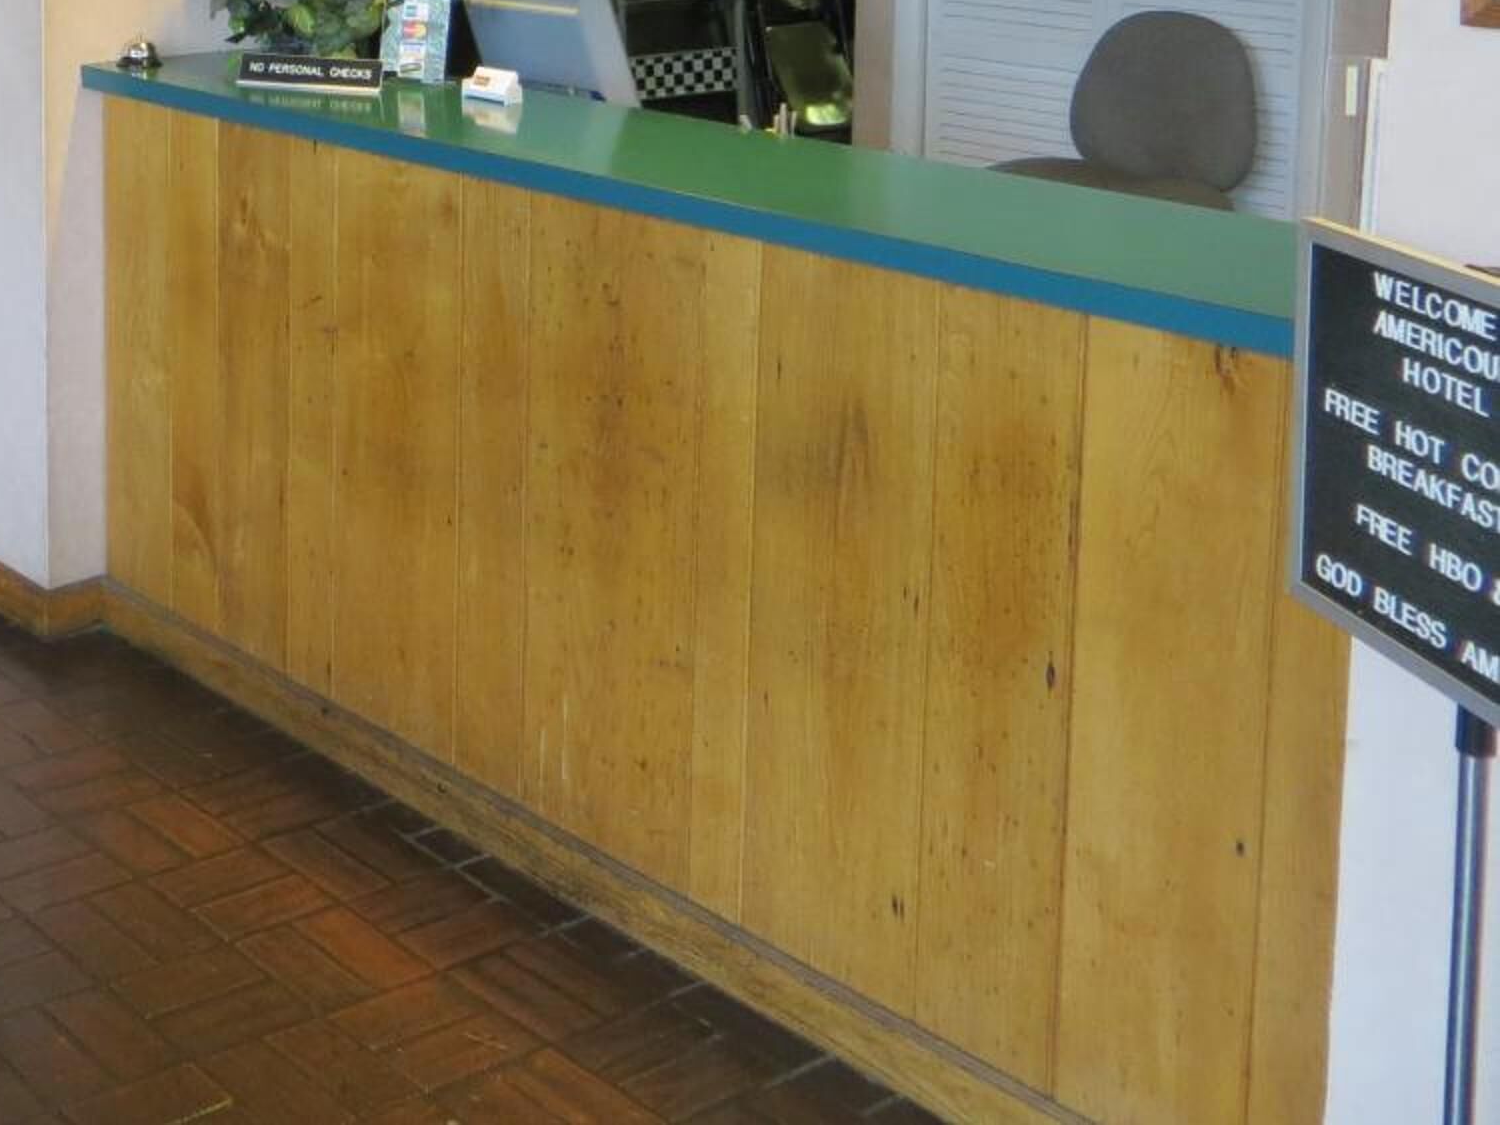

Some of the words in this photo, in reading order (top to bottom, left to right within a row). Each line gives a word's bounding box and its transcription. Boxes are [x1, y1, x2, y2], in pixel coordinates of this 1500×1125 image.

[249, 62, 264, 73] NO
[268, 63, 323, 77] PERSONAL
[329, 67, 373, 80] CHECKS
[1373, 271, 1497, 341] WELCOME
[1373, 310, 1500, 383] AMERICOU
[1402, 358, 1490, 418] HOTEL
[1325, 388, 1381, 435] FREE
[1395, 421, 1445, 465] HOT
[1461, 453, 1500, 491] CO
[1367, 445, 1500, 534] BREAKFAST
[1356, 504, 1413, 556] FREE
[1429, 543, 1483, 592] HBO
[1316, 554, 1363, 597] GOD
[1374, 586, 1447, 649] BLESS
